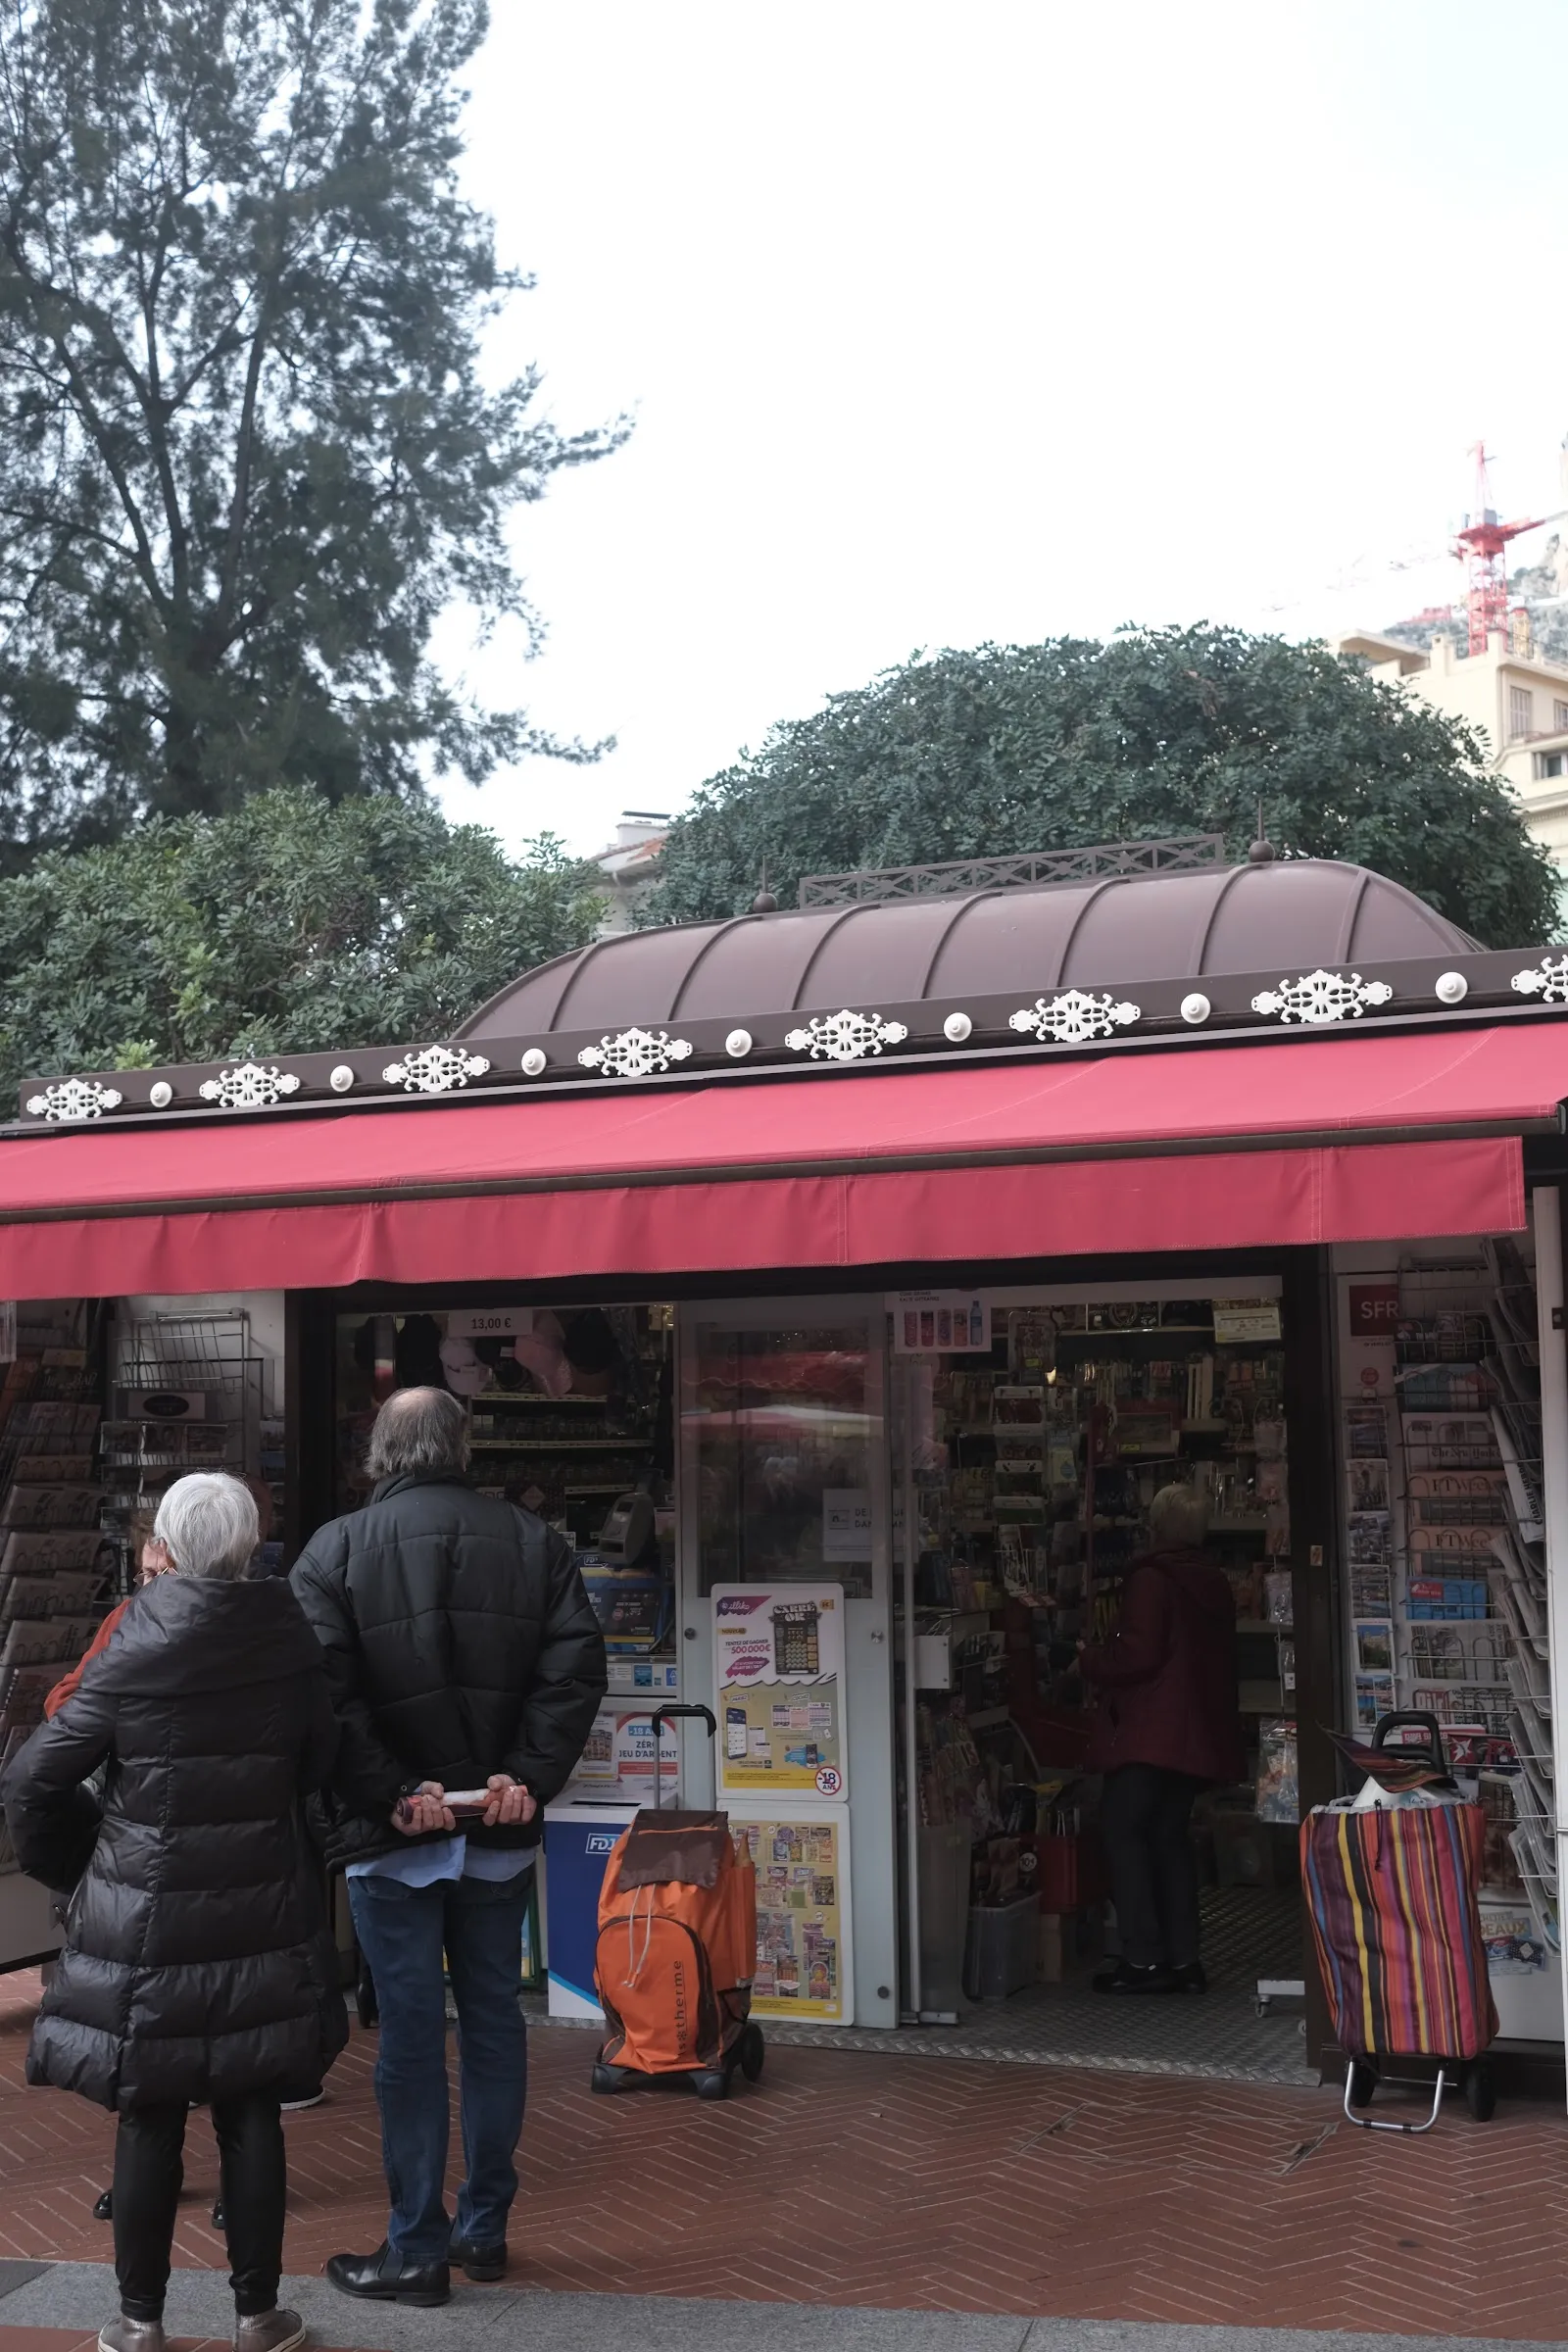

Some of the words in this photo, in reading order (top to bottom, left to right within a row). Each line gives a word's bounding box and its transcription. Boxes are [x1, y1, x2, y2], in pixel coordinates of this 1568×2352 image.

[1360, 1300, 1398, 1319] SFR
[470, 1318, 501, 1330] 13,00
[504, 1317, 512, 1328] €
[784, 1613, 806, 1622] OR
[731, 1645, 747, 1654] 500
[817, 1772, 836, 1785] -18
[589, 1838, 616, 1850] FDJ
